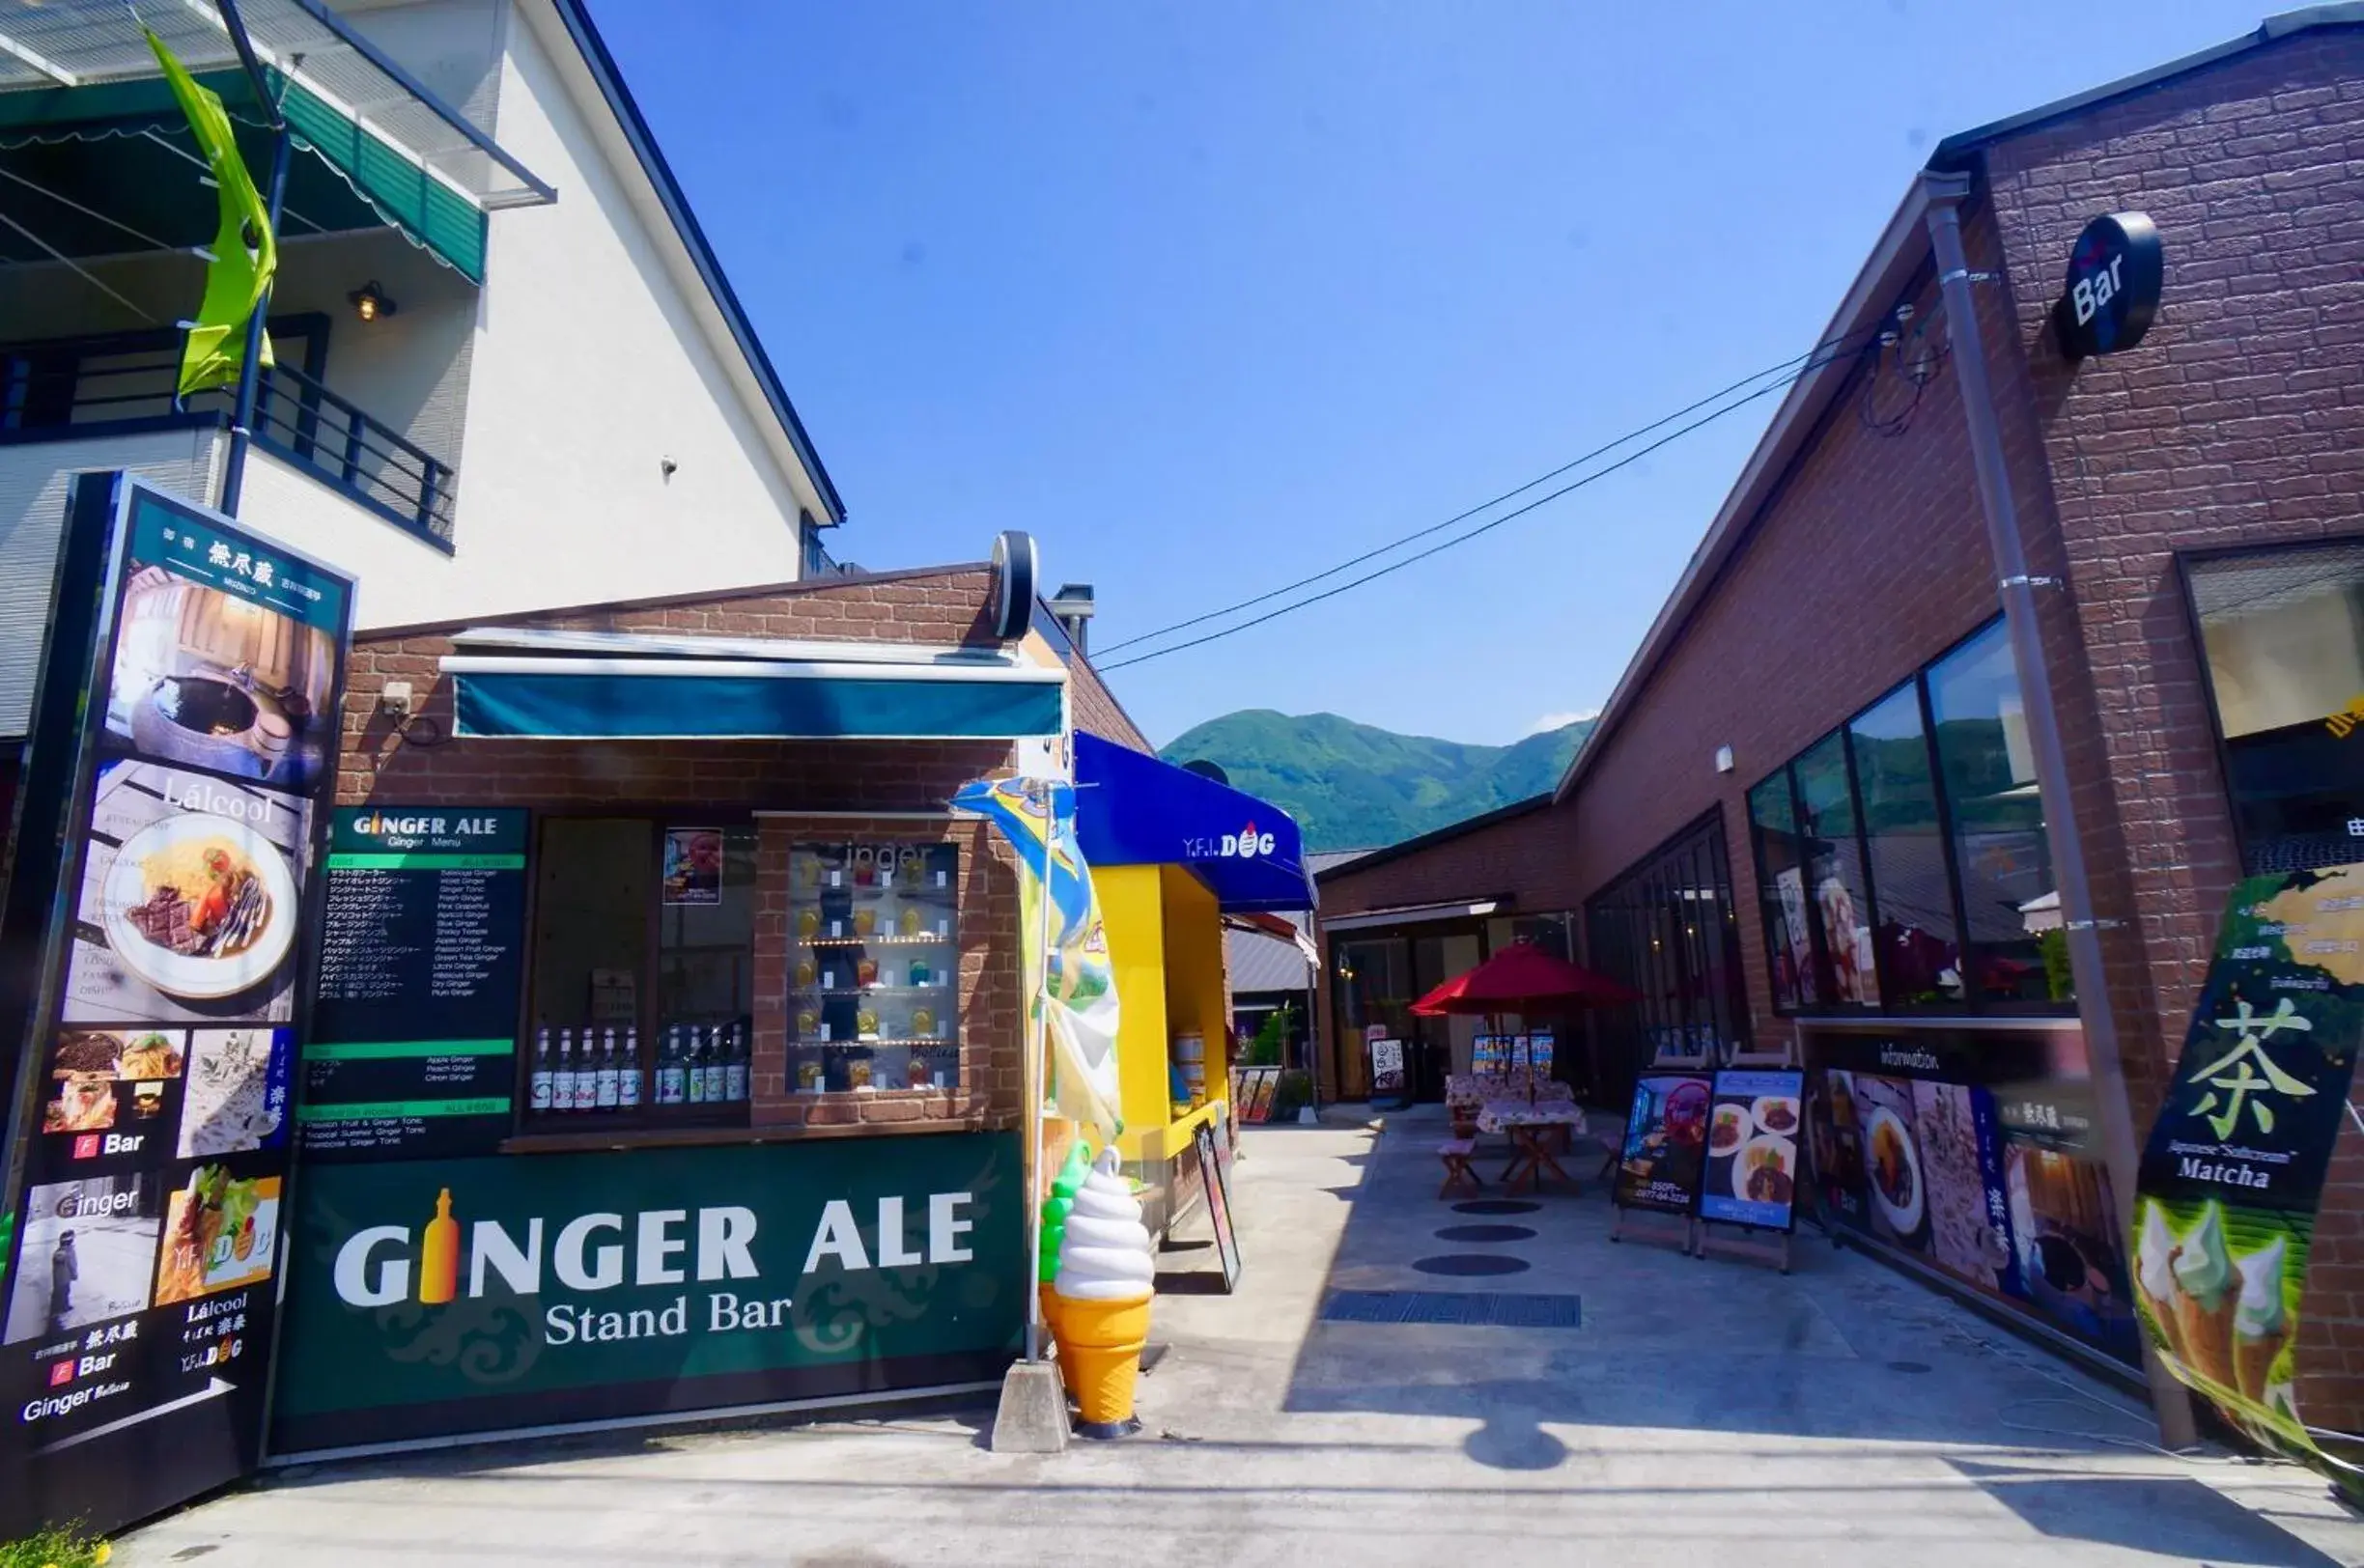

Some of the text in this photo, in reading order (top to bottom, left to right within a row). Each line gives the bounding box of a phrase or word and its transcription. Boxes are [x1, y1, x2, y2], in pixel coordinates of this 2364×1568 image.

[2072, 253, 2123, 326] Bar
[209, 541, 273, 588] 無尽蔵
[388, 836, 461, 849] Ginger Menu
[456, 819, 496, 834] ALE
[2186, 996, 2318, 1141] 茶
[104, 1134, 144, 1155] Bar
[2177, 1156, 2271, 1190] Matcha
[333, 1186, 974, 1309] GINGER ALE
[544, 1291, 792, 1346] Stand Bar
[77, 1352, 116, 1377] Bar
[22, 1389, 94, 1421] Ginger
